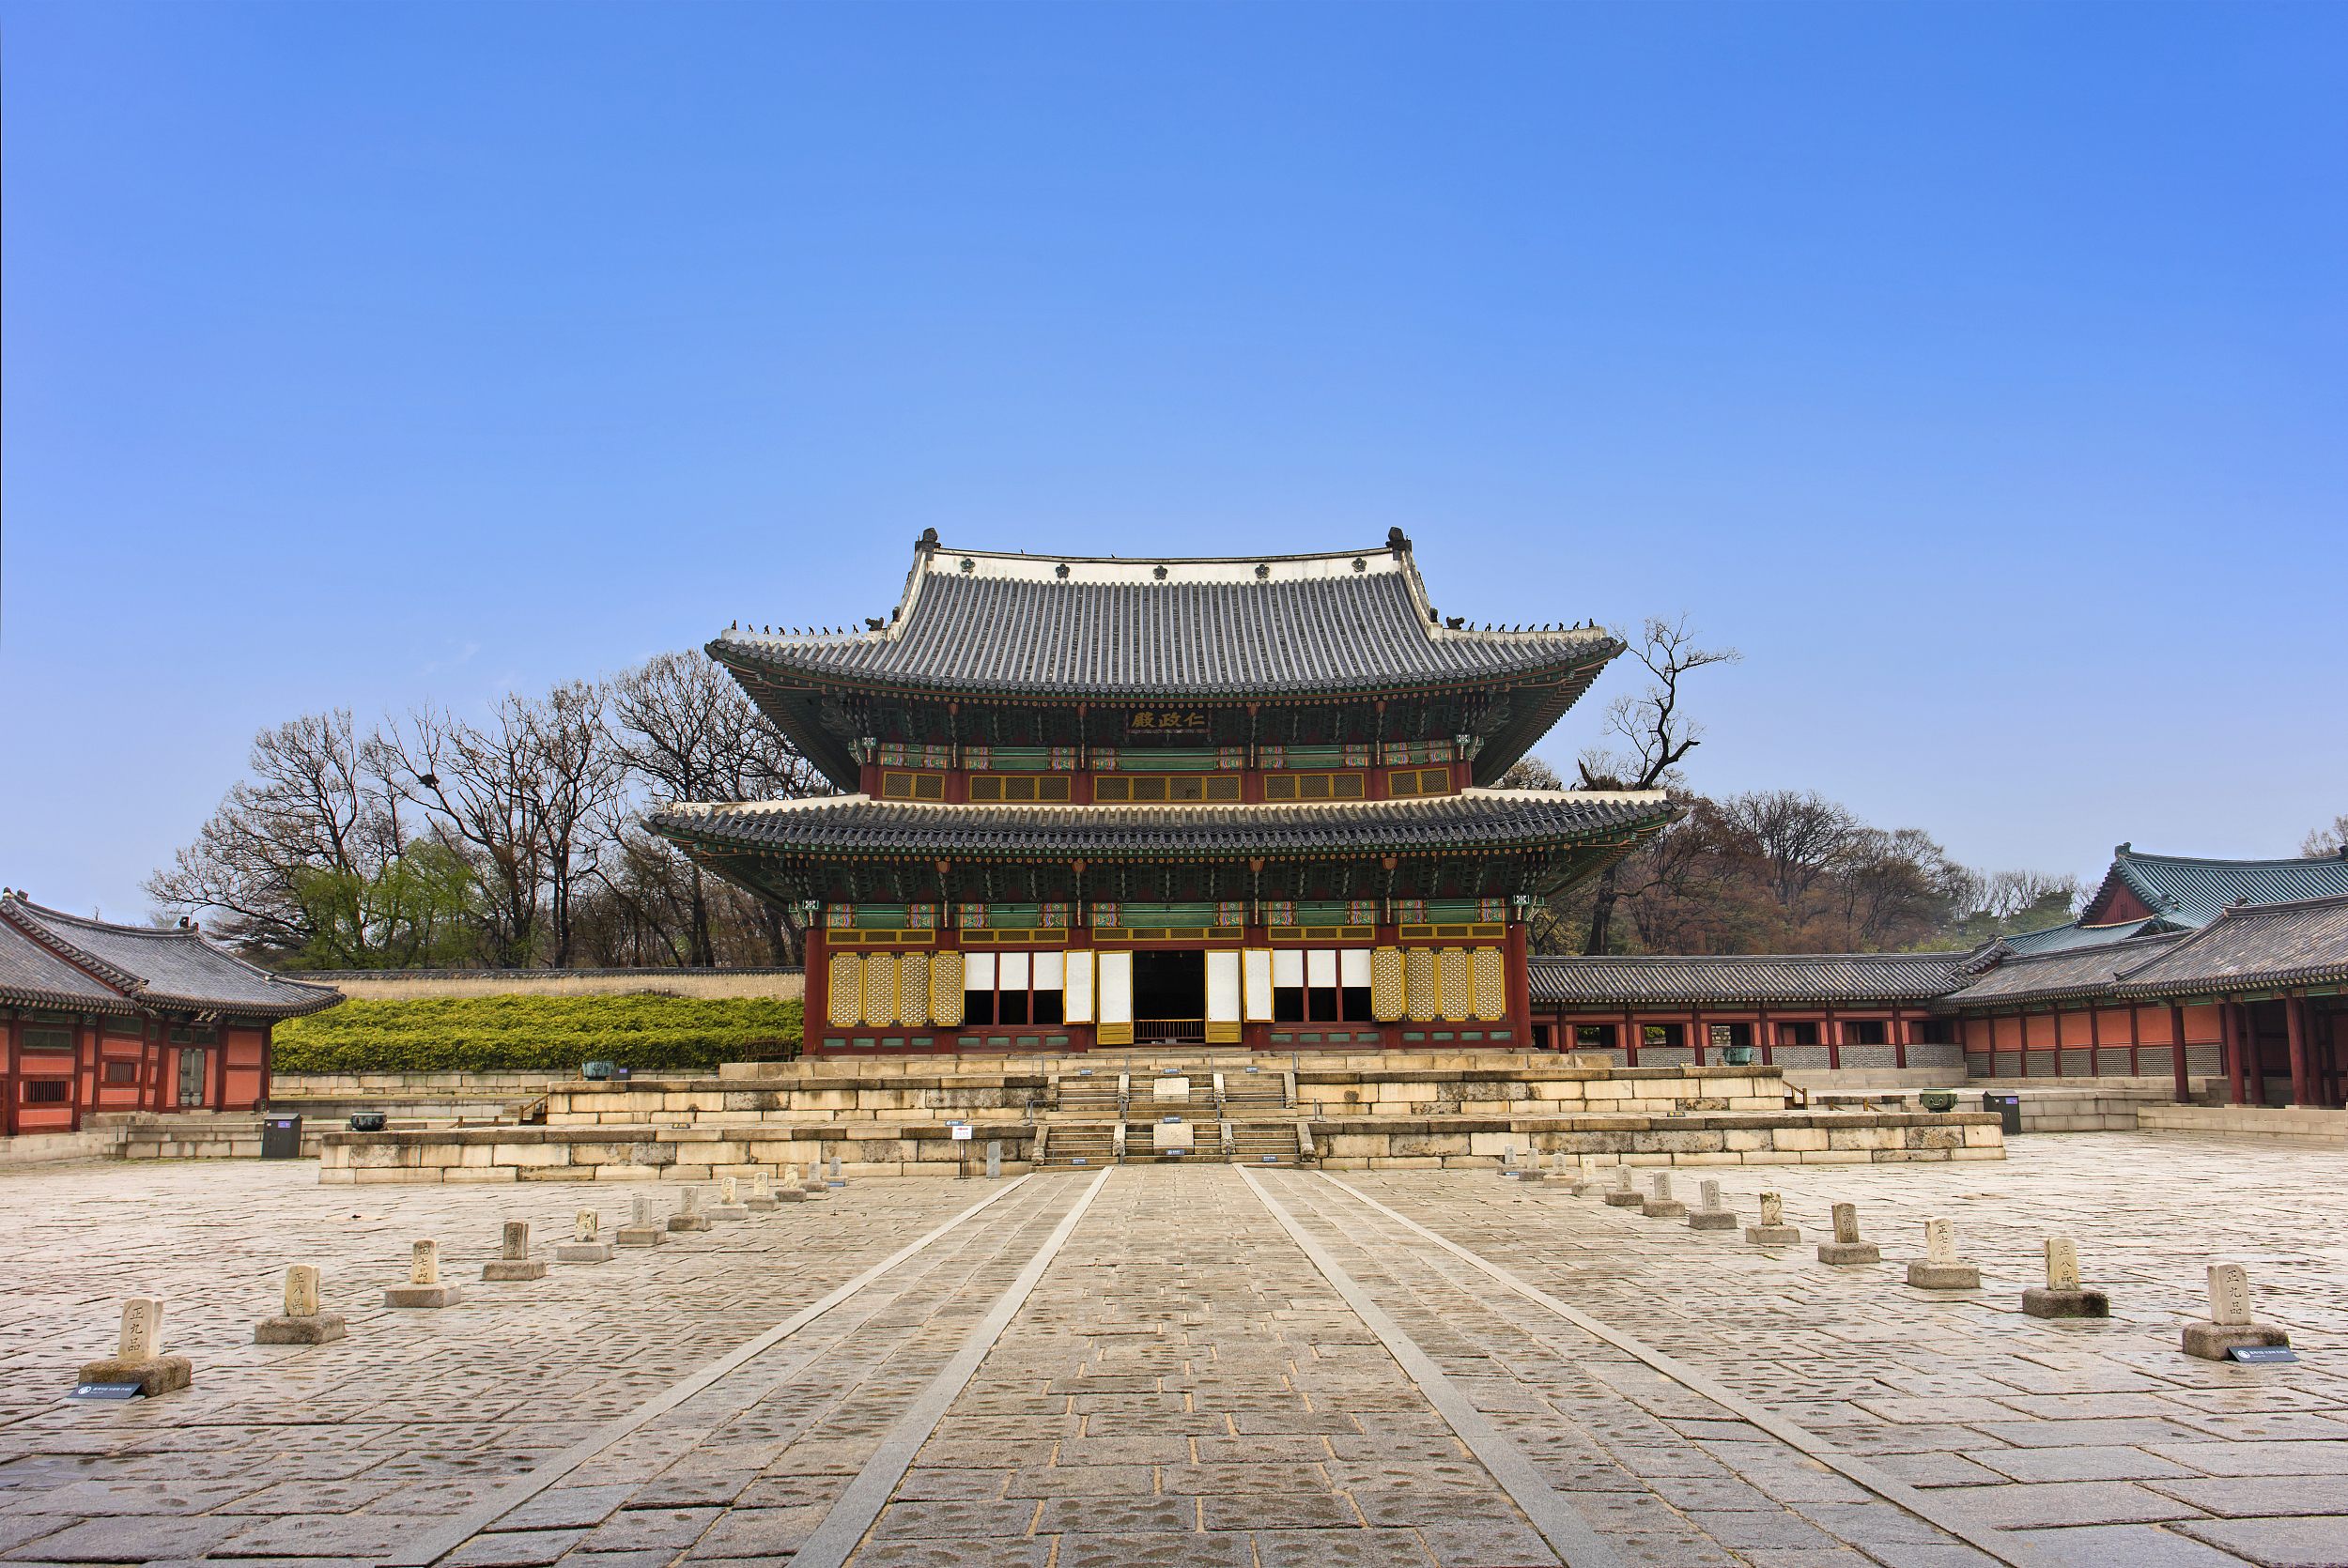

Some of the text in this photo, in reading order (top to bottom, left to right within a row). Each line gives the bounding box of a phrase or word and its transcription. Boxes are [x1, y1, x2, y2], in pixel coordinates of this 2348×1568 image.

[1131, 711, 1205, 728] 仁政殿
[1938, 1224, 1950, 1256] 正七品
[418, 1246, 428, 1280] 正七品
[2059, 1245, 2073, 1283] 正八品
[290, 1271, 305, 1310] 正八品
[2226, 1269, 2243, 1314] 正九品
[127, 1306, 144, 1353] 正九品
